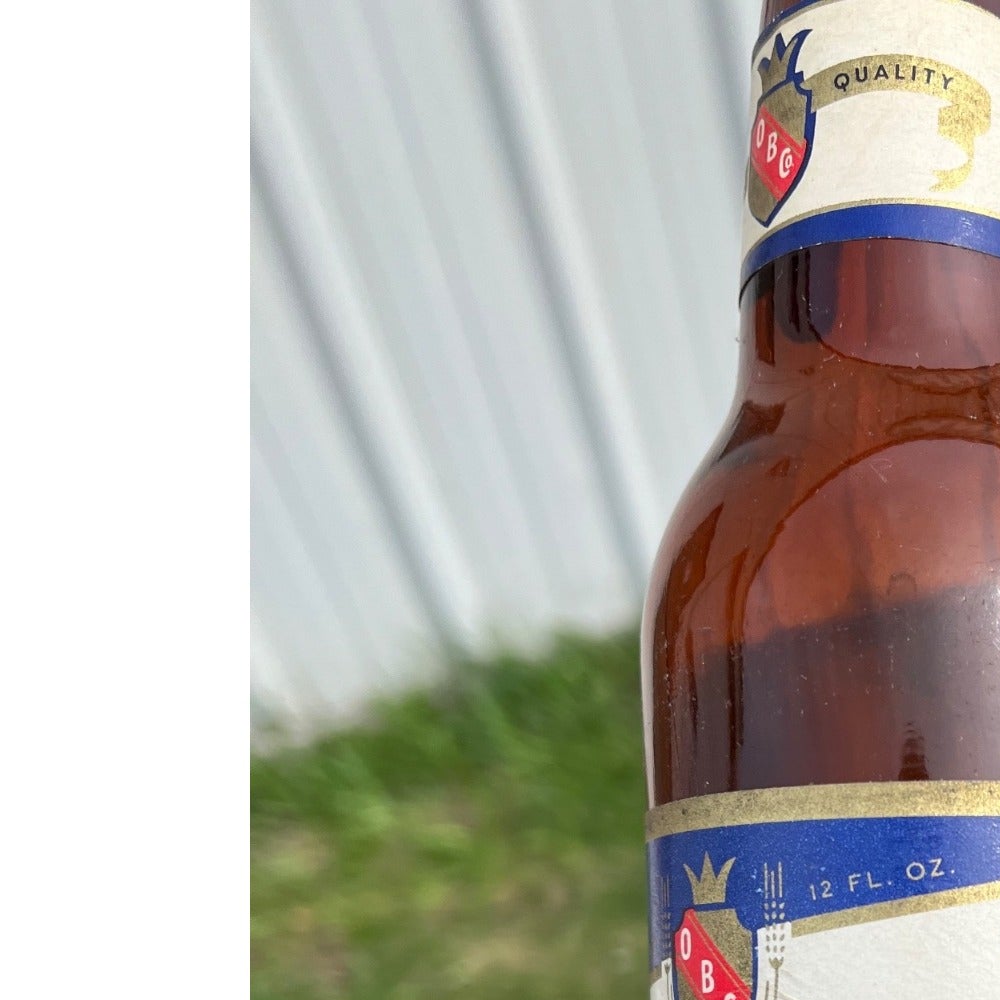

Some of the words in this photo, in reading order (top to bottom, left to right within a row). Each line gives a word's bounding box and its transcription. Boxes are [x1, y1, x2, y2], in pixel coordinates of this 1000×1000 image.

[834, 64, 954, 92] QUALITY
[809, 881, 833, 900] 12
[848, 872, 892, 892] FL.
[906, 858, 956, 881] OZ.
